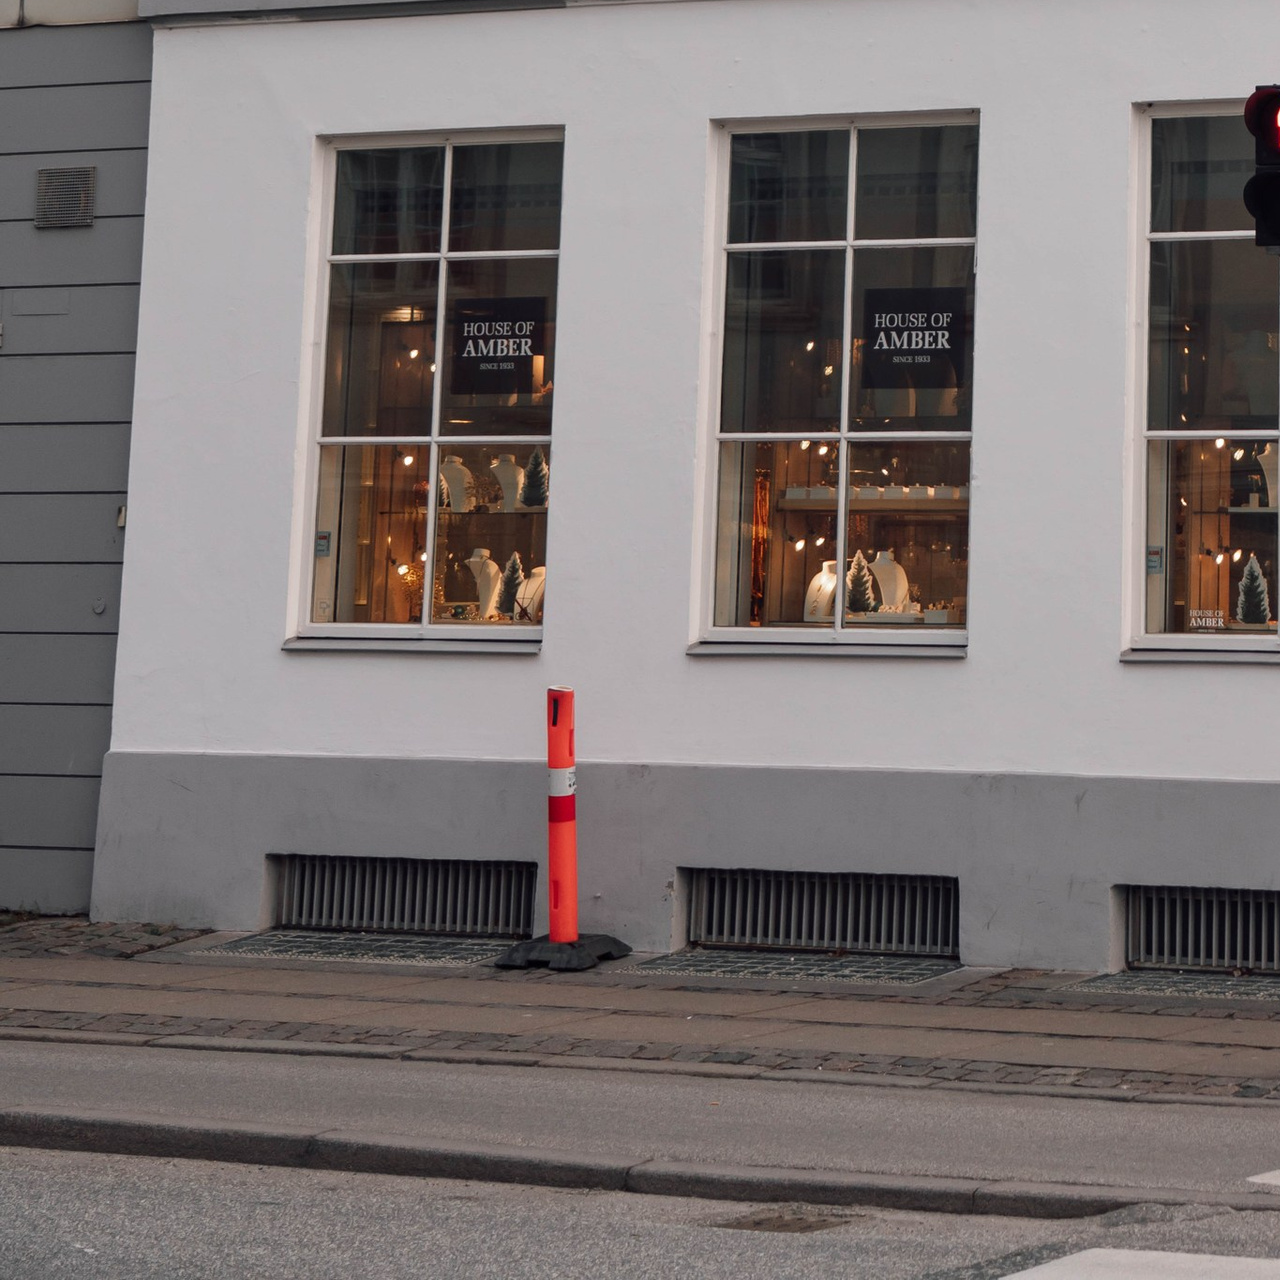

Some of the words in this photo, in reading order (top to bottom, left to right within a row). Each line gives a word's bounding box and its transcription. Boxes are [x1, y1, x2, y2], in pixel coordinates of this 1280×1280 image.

[874, 313, 927, 328] HOUSE
[931, 312, 953, 327] OF
[463, 322, 512, 336] HOUSE
[515, 321, 535, 335] OF
[462, 338, 534, 357] AMBER
[873, 330, 951, 350] AMBER
[892, 355, 913, 363] SINCE
[1190, 617, 1225, 627] AMBER
